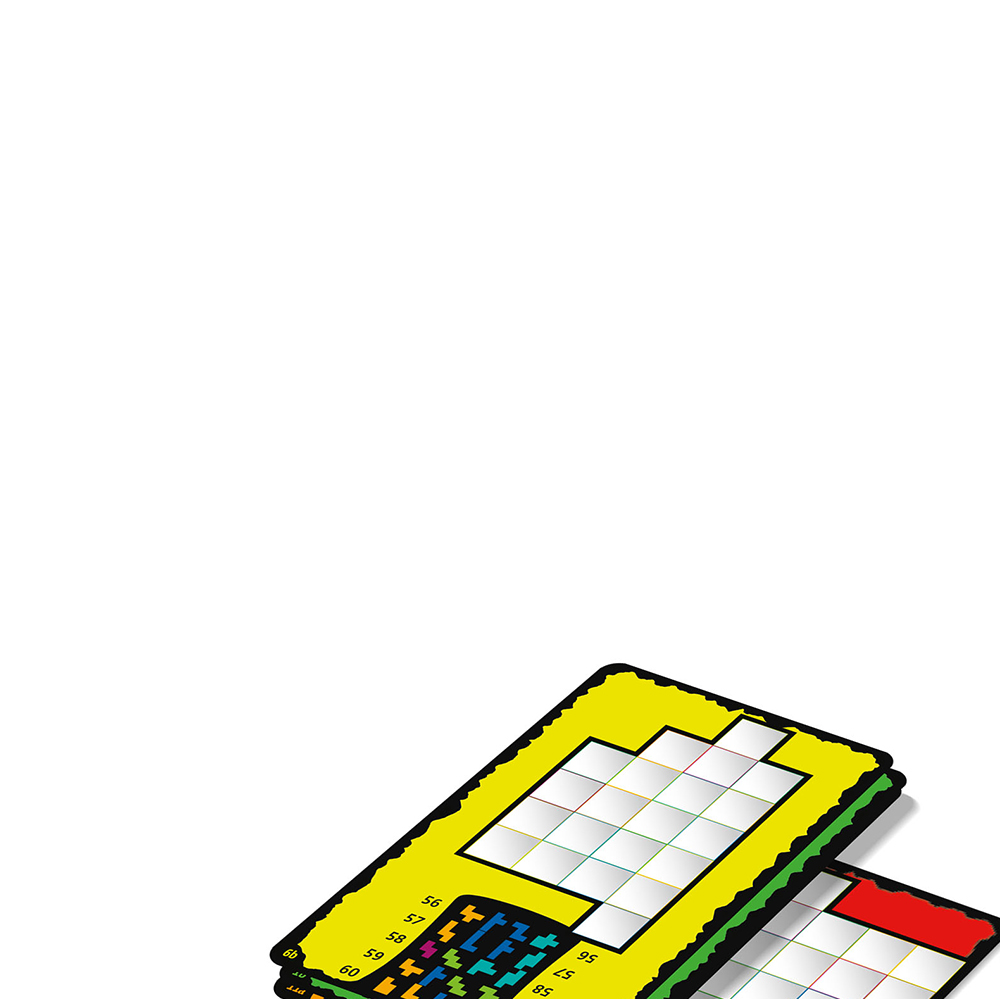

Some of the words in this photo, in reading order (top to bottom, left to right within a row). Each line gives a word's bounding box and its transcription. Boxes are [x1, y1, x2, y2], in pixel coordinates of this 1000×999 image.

[421, 895, 443, 908] 56
[403, 913, 426, 925] 57
[385, 931, 407, 943] 58
[283, 949, 299, 960] 6b
[363, 948, 385, 960] 59
[577, 951, 598, 964] 56
[339, 965, 360, 977] 60
[552, 968, 575, 980] 57
[532, 984, 554, 997] 58
